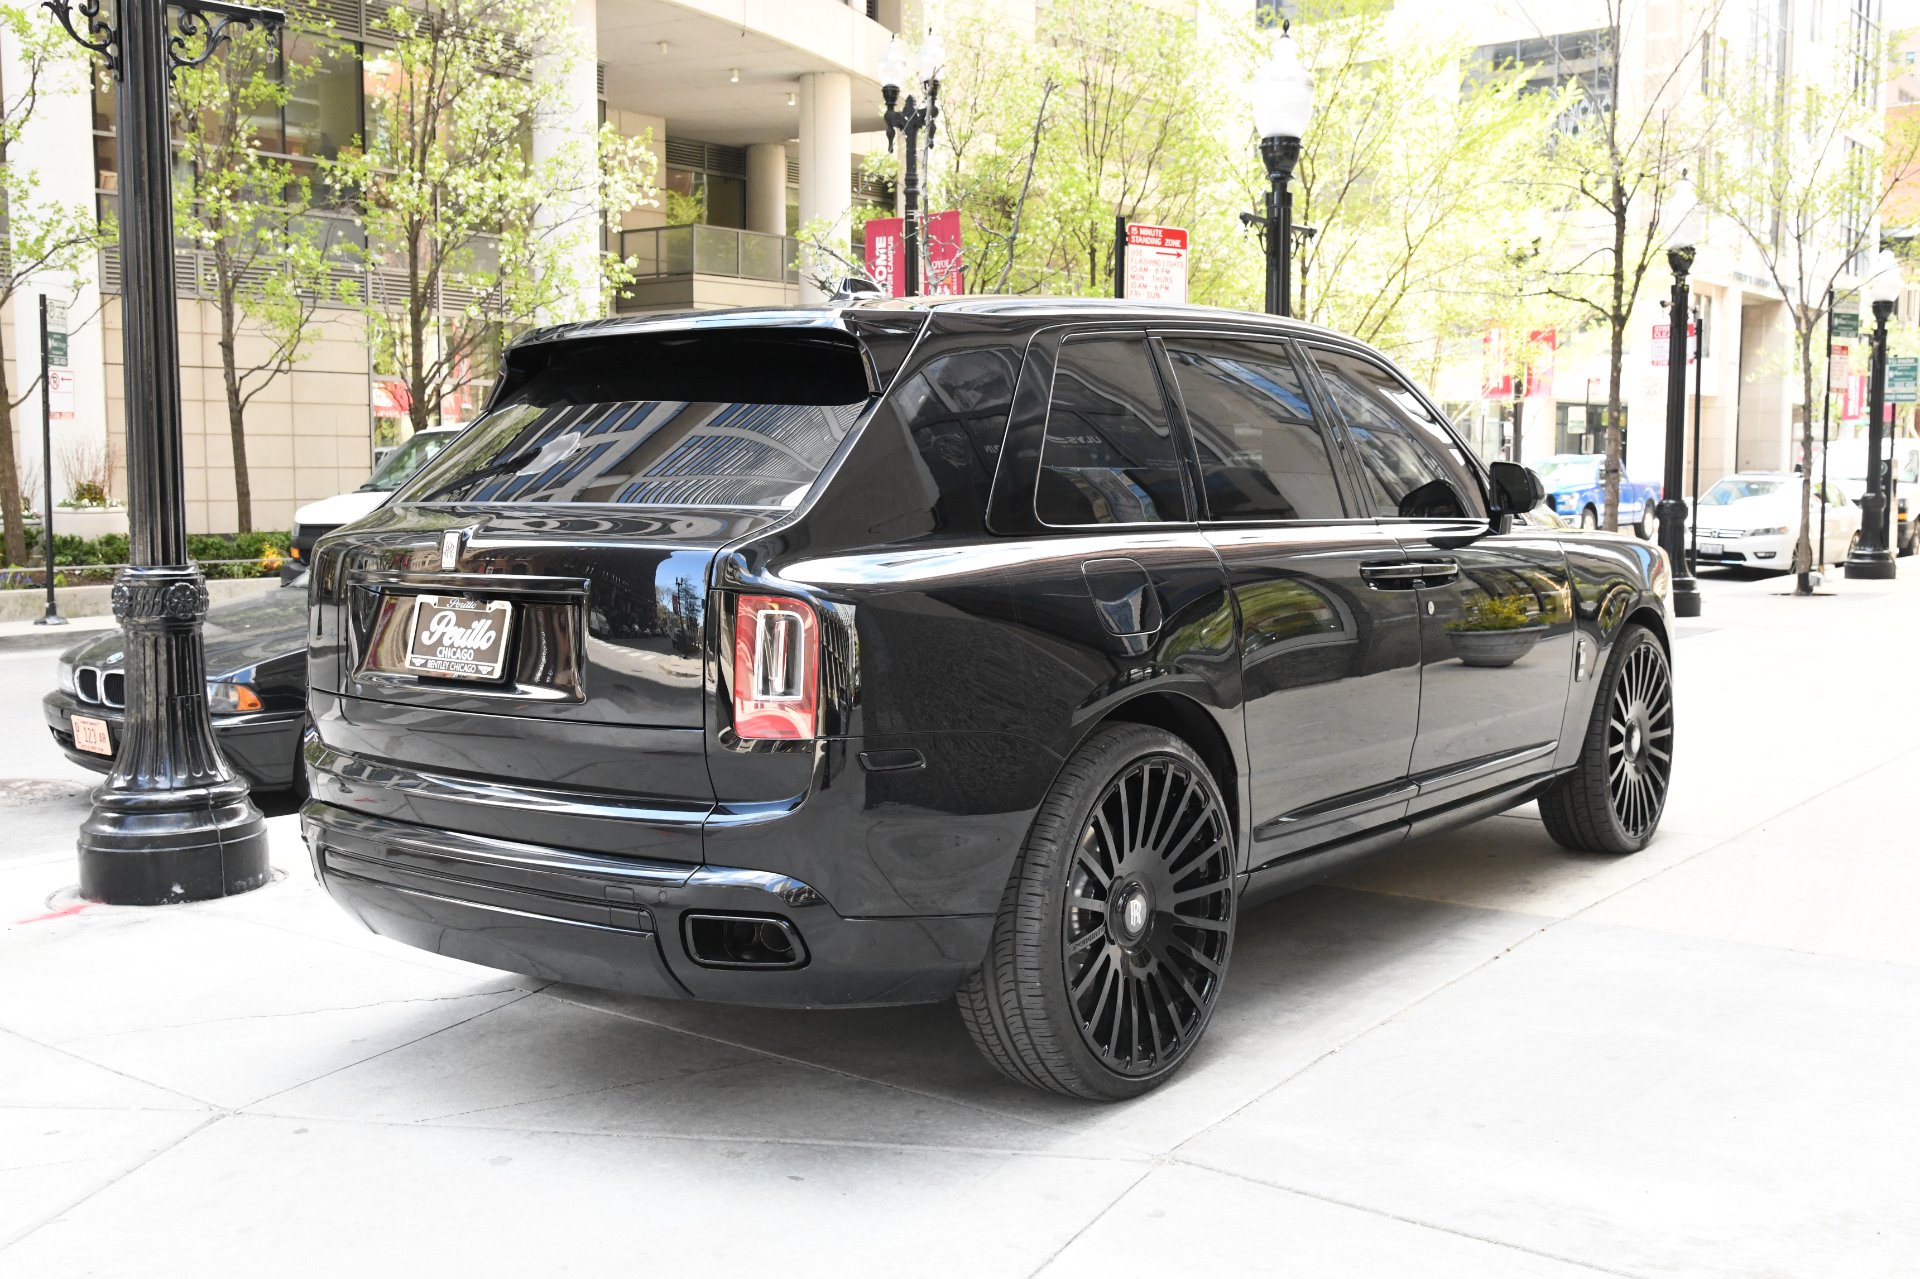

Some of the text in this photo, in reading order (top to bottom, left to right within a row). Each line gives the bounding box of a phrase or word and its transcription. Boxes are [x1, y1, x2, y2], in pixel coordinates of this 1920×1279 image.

[1131, 227, 1163, 238] 15 MINUTE
[1131, 235, 1181, 247] STANDING ZONE
[875, 236, 887, 283] OME
[446, 598, 477, 609] Perillo
[421, 610, 497, 651] Perillo
[436, 646, 474, 661] CHICAGO
[427, 659, 477, 673] BENTLEY CHICAGO
